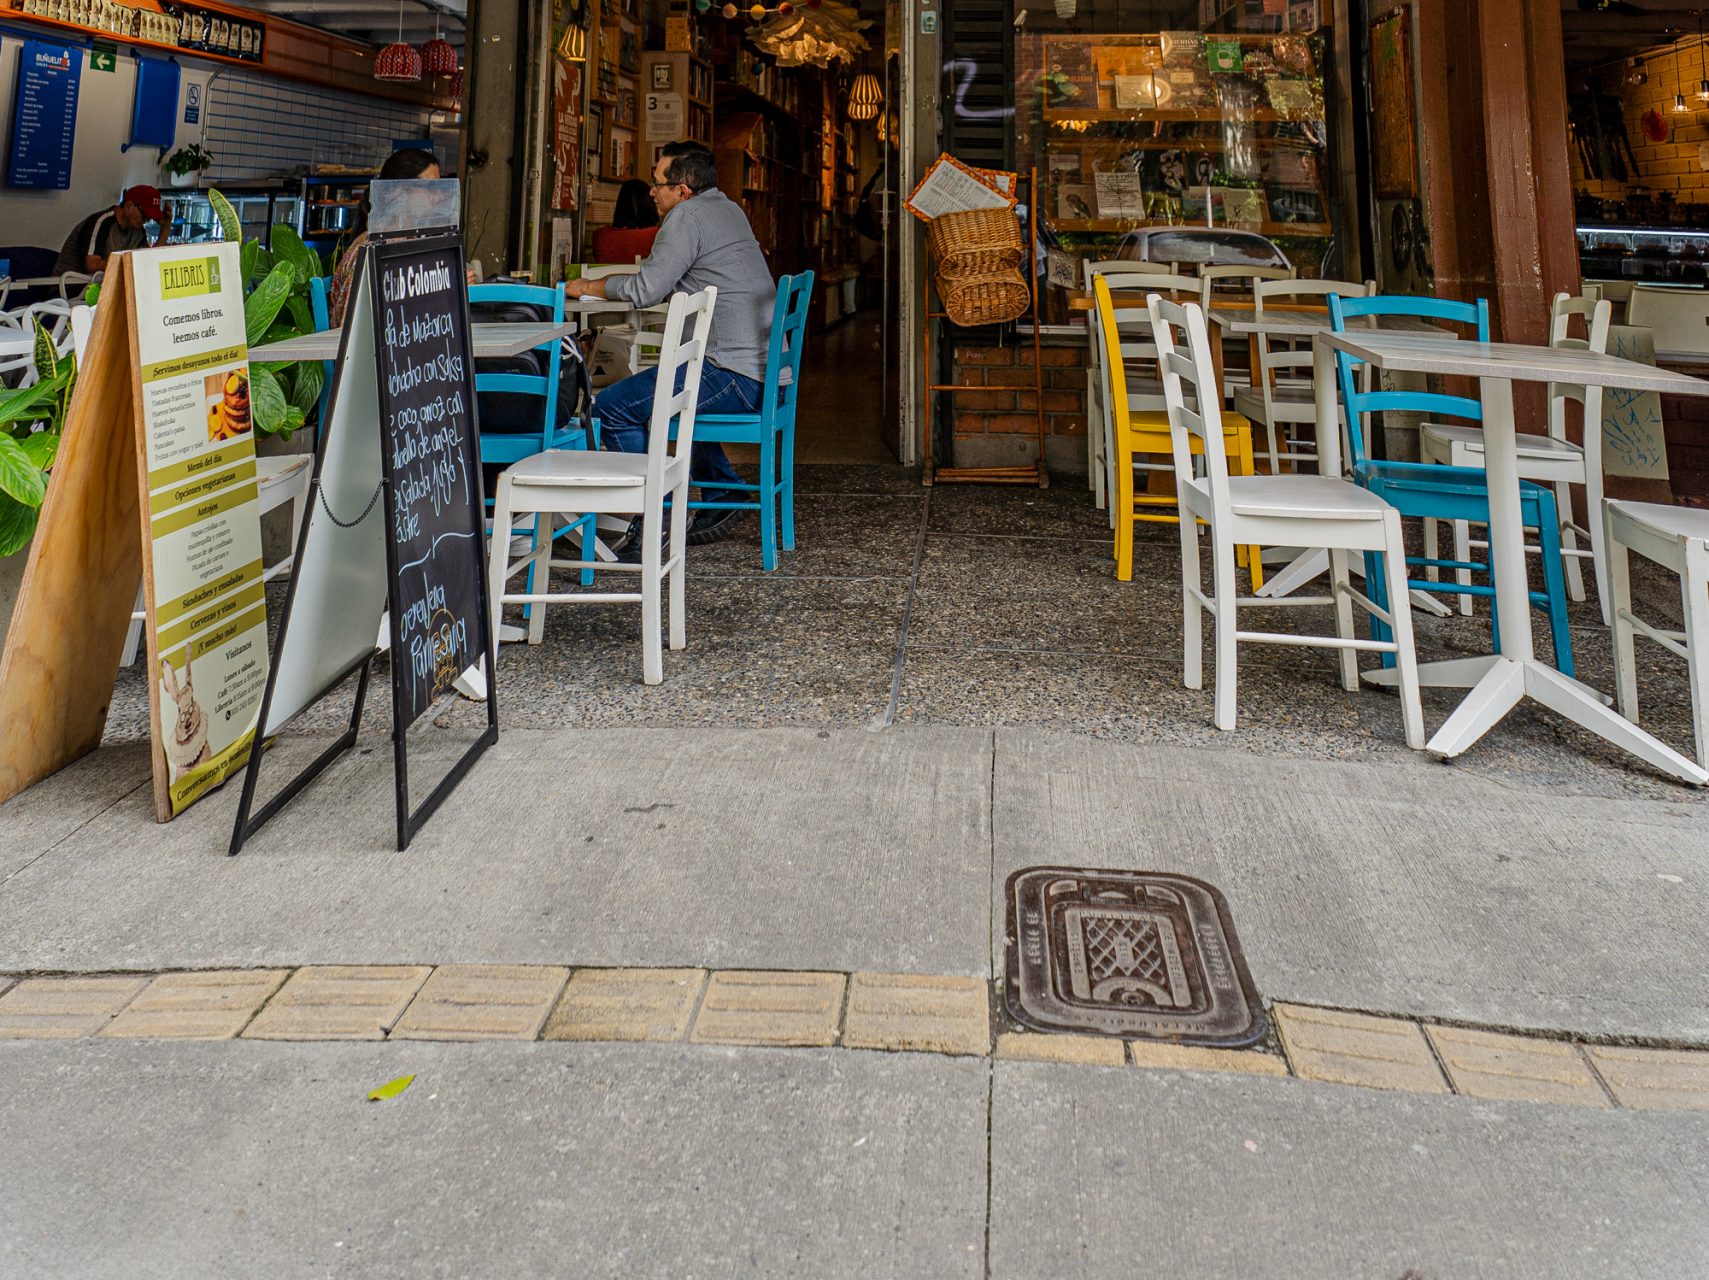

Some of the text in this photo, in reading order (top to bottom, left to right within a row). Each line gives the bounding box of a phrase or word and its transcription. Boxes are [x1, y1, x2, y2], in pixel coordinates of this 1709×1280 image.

[648, 96, 657, 110] 3
[163, 264, 205, 290] EXLIBRIS
[383, 260, 451, 302] Club Colombia
[163, 312, 200, 327] Comemos
[398, 305, 411, 347] de
[172, 331, 199, 344] leemos
[152, 364, 181, 378] ¡Servimos
[182, 357, 210, 369] desayunos
[211, 354, 223, 363] todo
[423, 359, 439, 382] con
[446, 390, 464, 416] con
[187, 454, 222, 472] Menú del día
[175, 472, 236, 501] Opciones vegetarianas
[218, 573, 244, 592] ensaladas
[190, 612, 216, 630] Cervezas
[221, 600, 237, 613] vinos
[205, 633, 224, 648] mucho
[224, 671, 237, 683] Lunes
